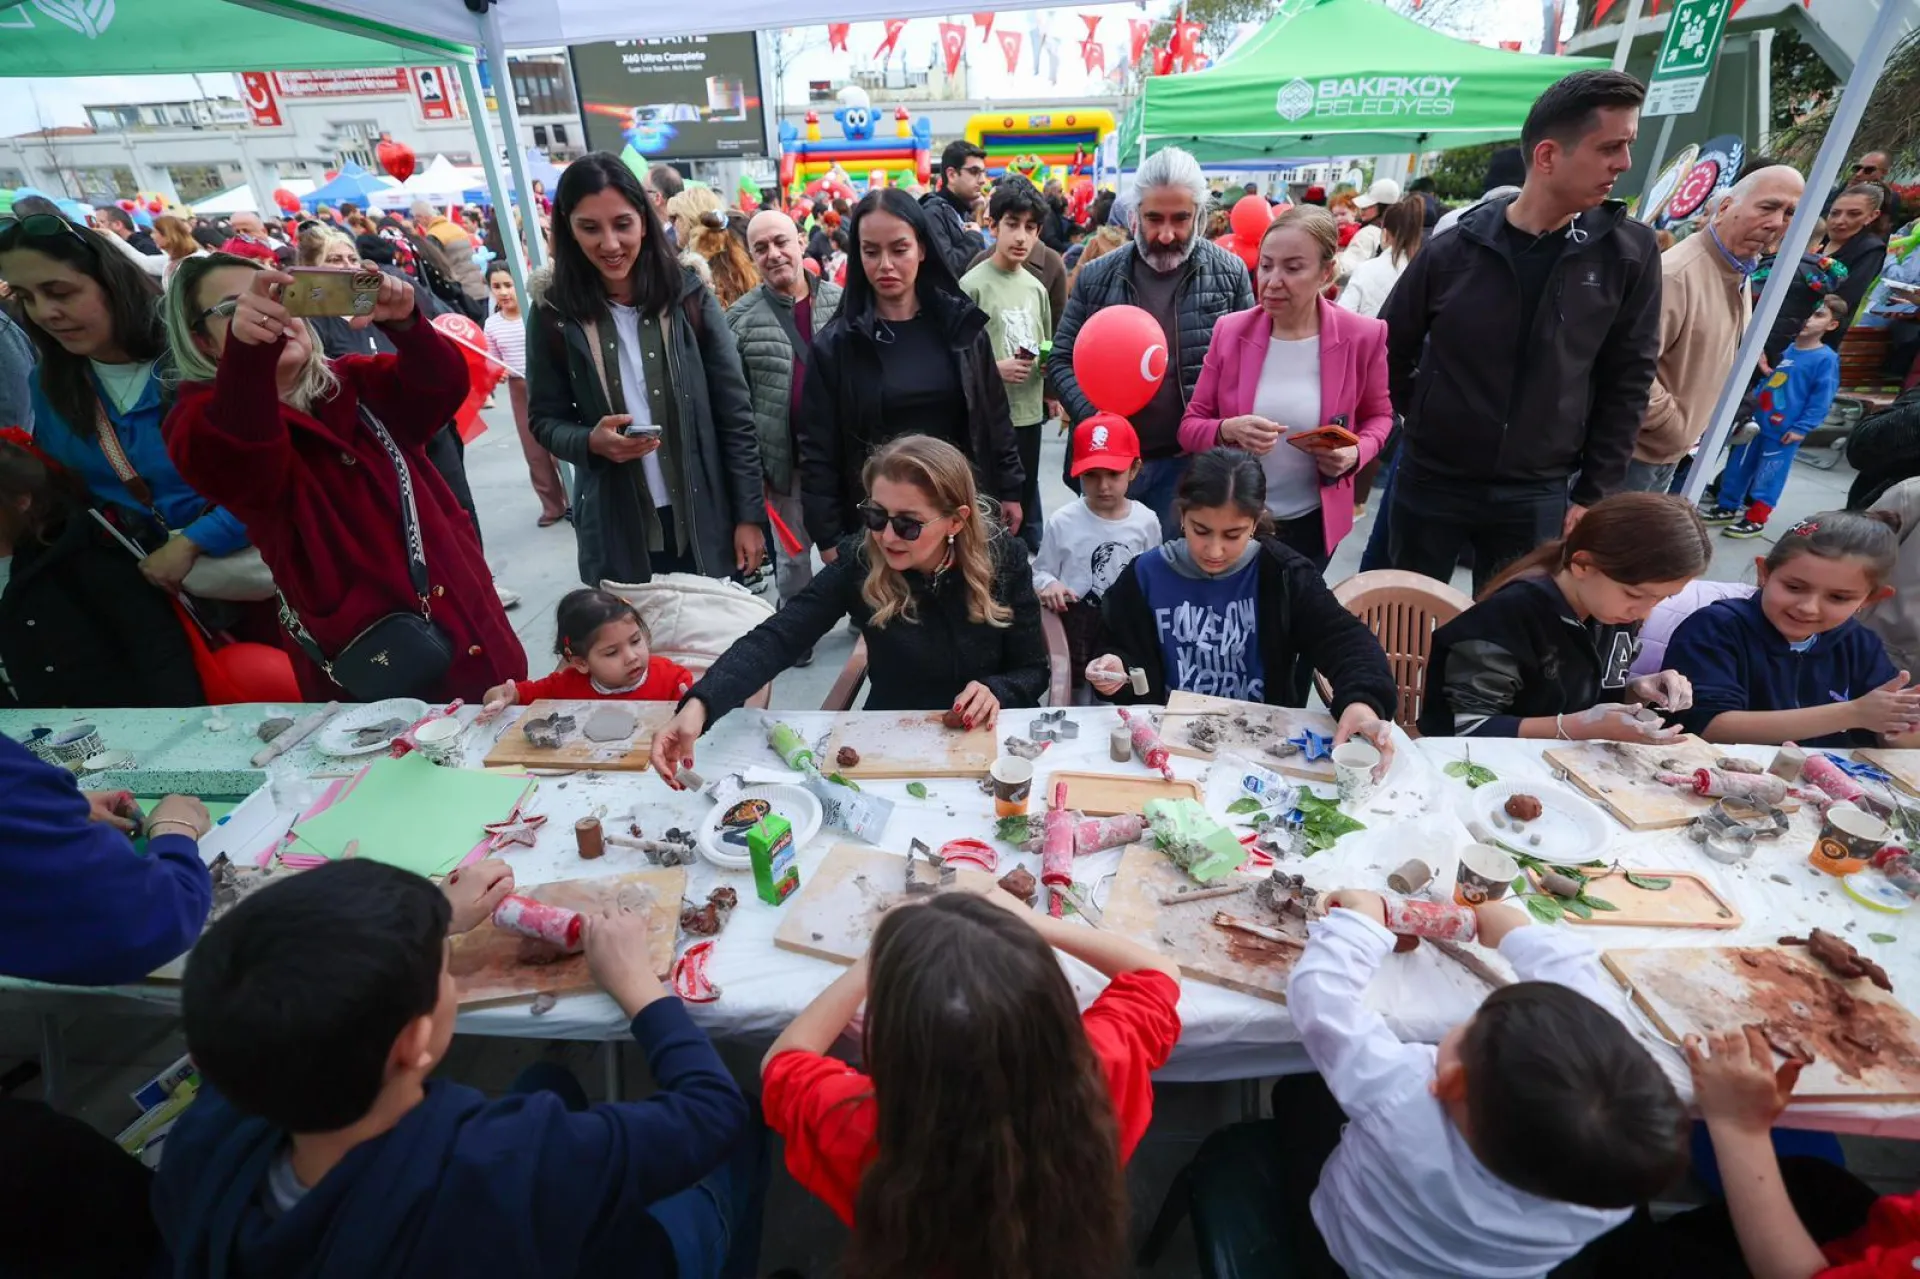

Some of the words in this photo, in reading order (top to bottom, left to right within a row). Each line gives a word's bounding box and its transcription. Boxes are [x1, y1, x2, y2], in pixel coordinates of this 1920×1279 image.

[641, 52, 662, 63] Ultra
[664, 51, 706, 63] Complete
[1318, 75, 1460, 97] BAKIRKÖY
[1602, 632, 1633, 688] A
